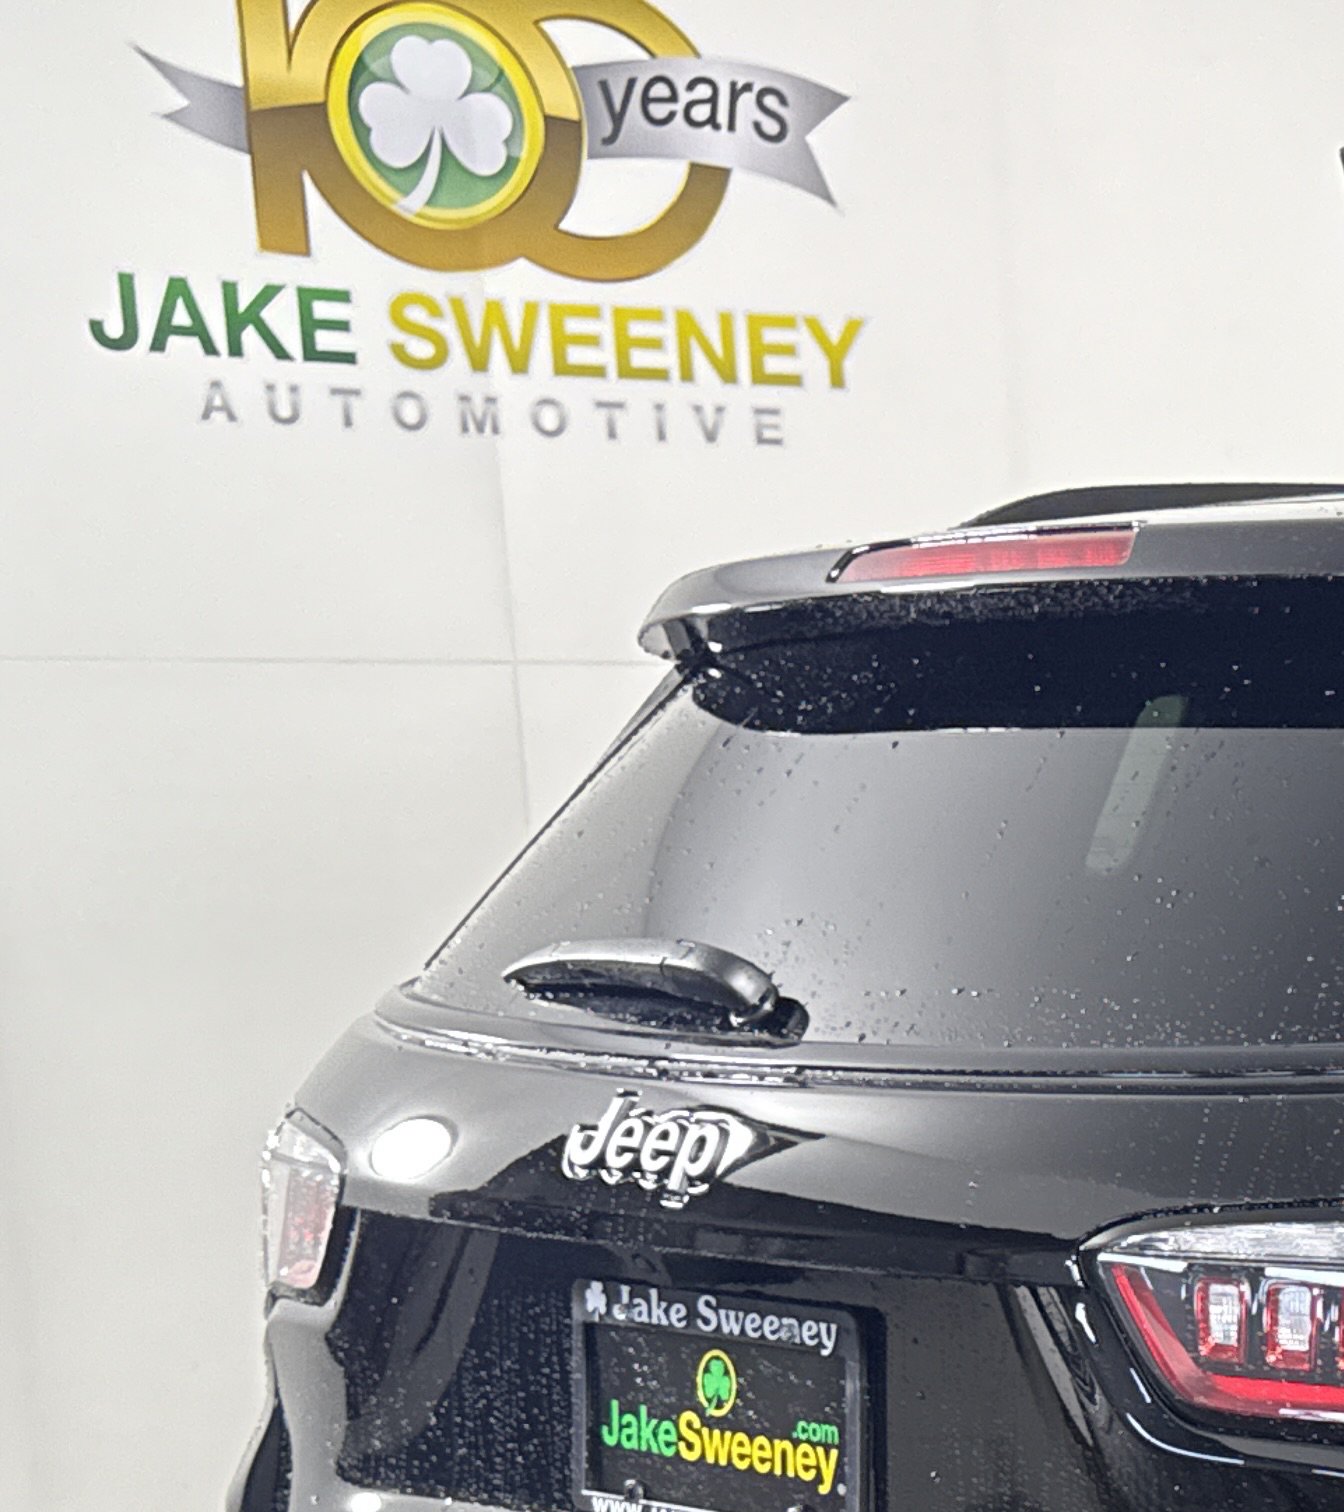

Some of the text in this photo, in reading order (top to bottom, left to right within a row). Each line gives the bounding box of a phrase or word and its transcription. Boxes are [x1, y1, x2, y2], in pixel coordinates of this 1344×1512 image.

[597, 72, 791, 143] years
[89, 271, 865, 389] JAKE SWEENEY
[200, 380, 785, 447] AUTOMOTIVE
[565, 1092, 722, 1203] Jeep
[612, 1285, 838, 1356] Jake Sweeney
